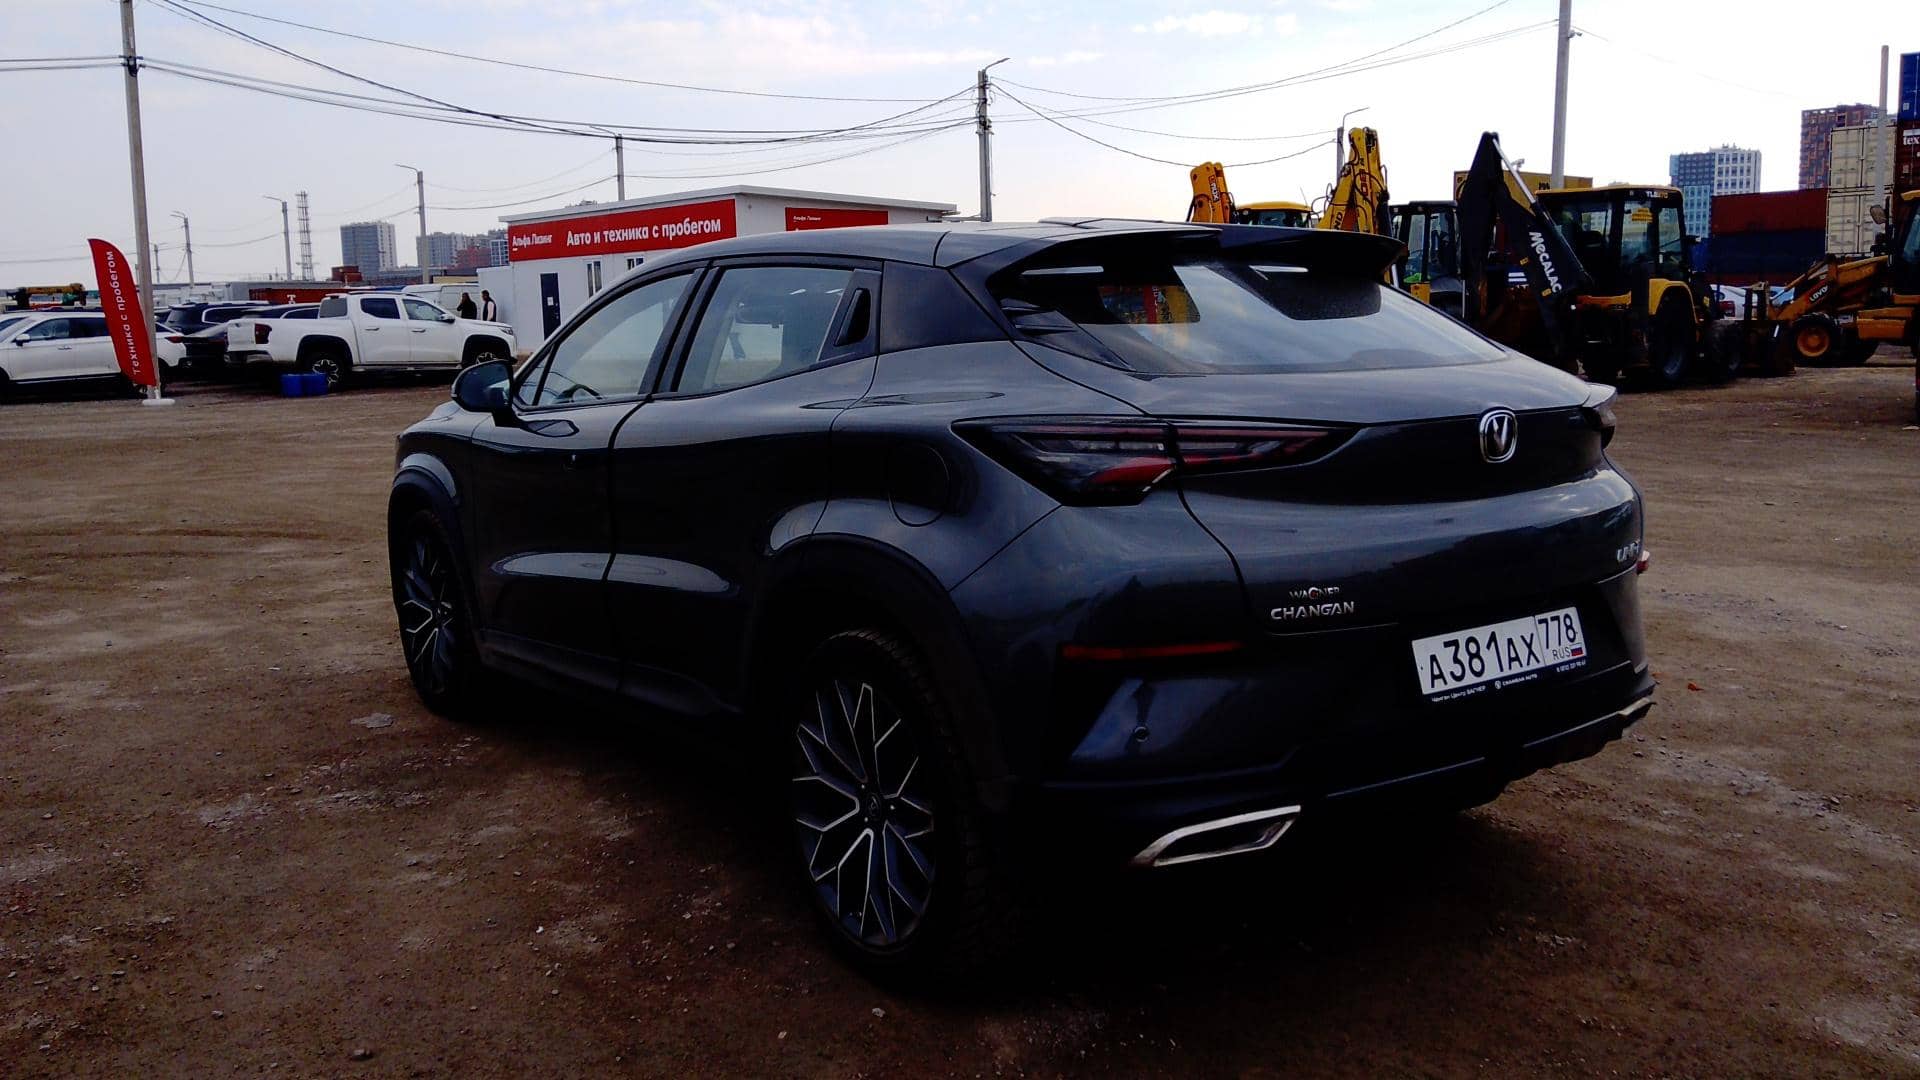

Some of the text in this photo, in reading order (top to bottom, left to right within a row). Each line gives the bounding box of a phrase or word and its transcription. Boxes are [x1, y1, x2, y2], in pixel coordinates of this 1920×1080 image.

[512, 235, 531, 248] Альфа
[566, 217, 721, 247] Авто и техника с пробегом
[106, 251, 126, 311] пробегом
[1289, 586, 1340, 599] WAGNER
[1270, 601, 1355, 620] CHANGAN
[1537, 613, 1577, 650] 778
[1552, 646, 1571, 661] RUS
